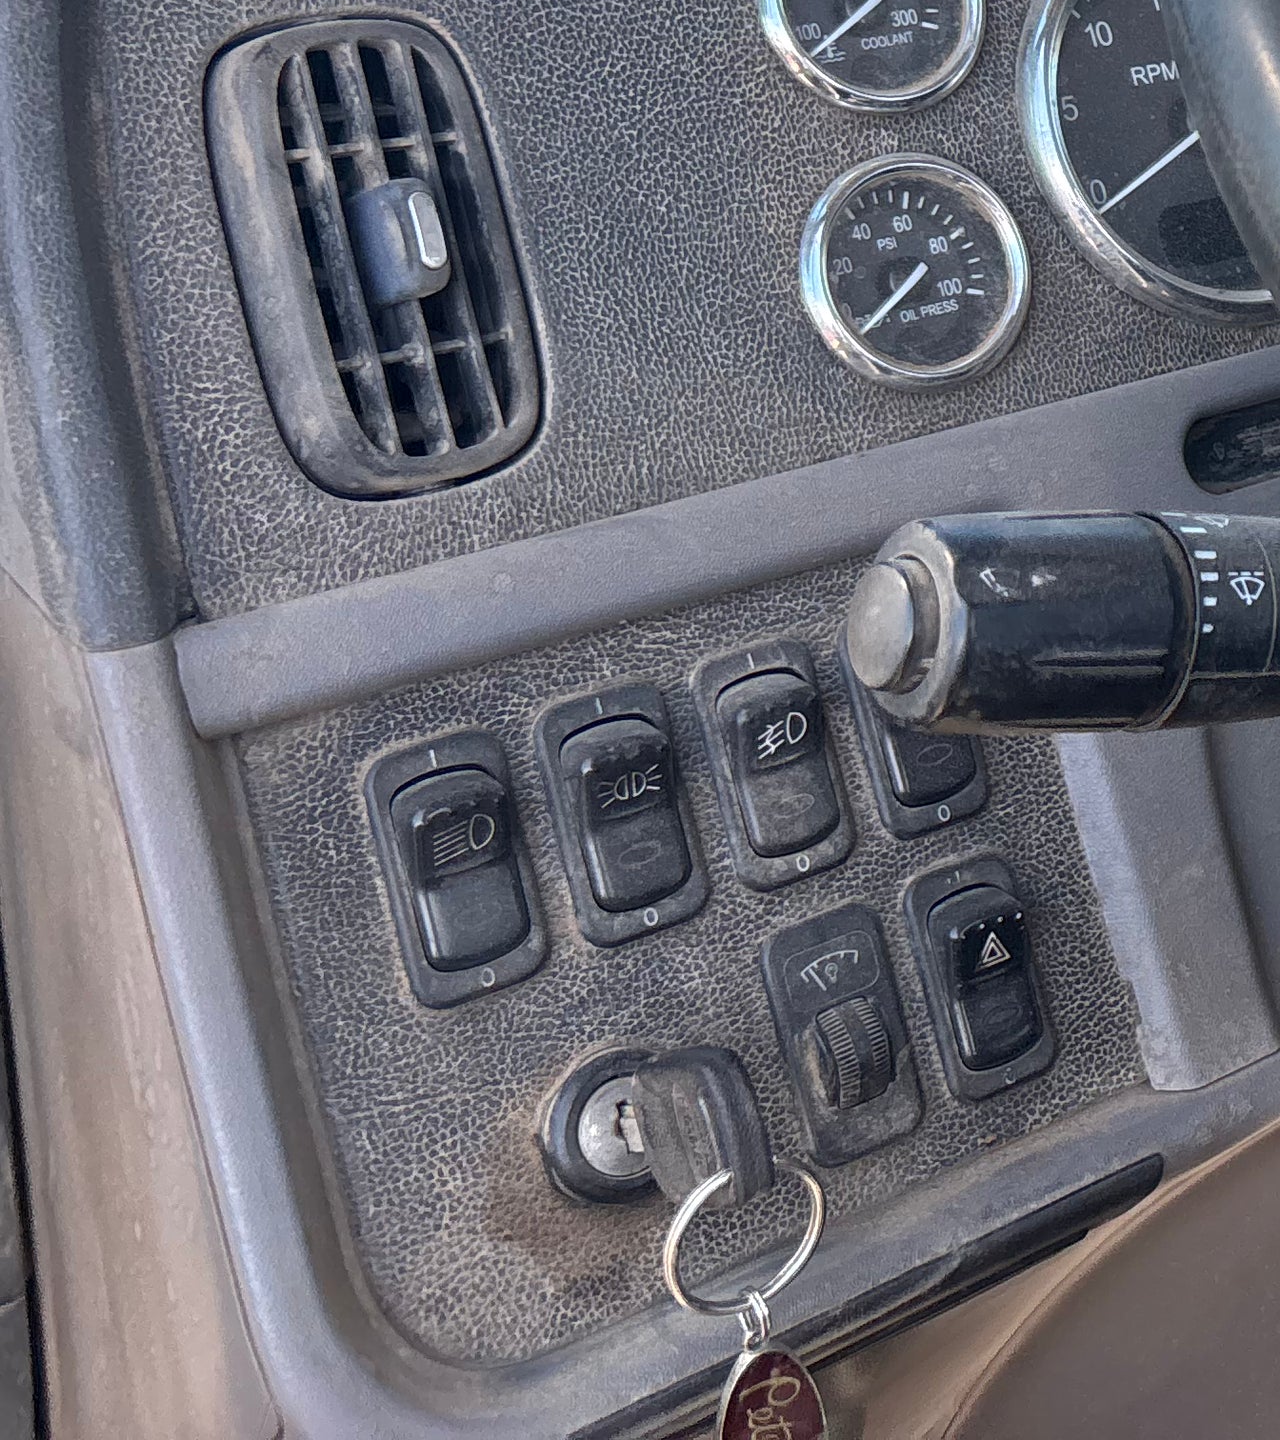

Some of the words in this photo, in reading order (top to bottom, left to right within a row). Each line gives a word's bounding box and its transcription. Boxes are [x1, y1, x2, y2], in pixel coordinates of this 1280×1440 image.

[890, 8, 918, 28] 300
[795, 23, 821, 41] 100
[861, 31, 914, 51] COOLANT
[1085, 21, 1114, 48] 10
[1130, 60, 1181, 87] RPM
[1062, 95, 1079, 121] 5
[1090, 179, 1107, 205] 0
[851, 222, 871, 242] 40
[892, 213, 913, 234] 60
[876, 236, 898, 252] PSI
[928, 236, 948, 255] 80
[832, 256, 853, 276] 20
[936, 277, 962, 297] 100
[900, 309, 920, 324] OIL
[920, 298, 959, 317] PRESS
